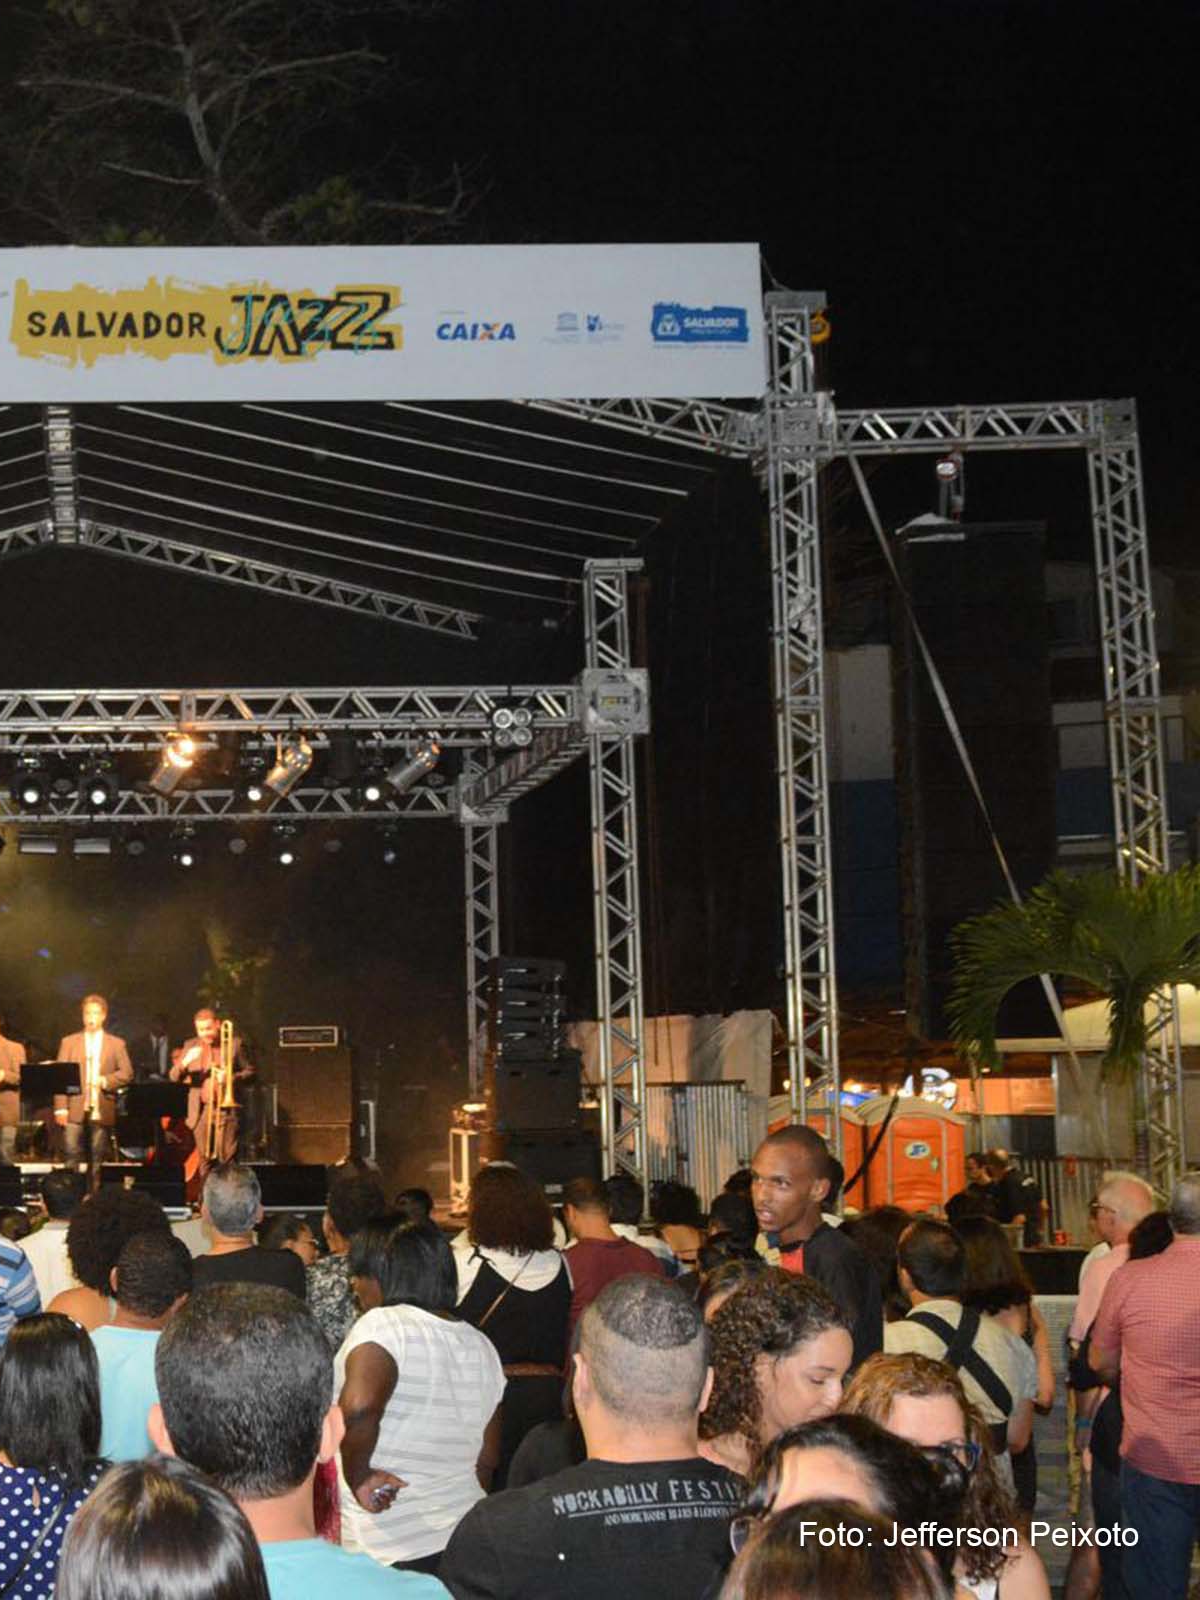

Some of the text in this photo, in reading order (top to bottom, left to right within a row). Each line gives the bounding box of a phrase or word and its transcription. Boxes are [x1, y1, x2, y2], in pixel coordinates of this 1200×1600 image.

[27, 291, 396, 356] SALVADOR JAZZ
[436, 323, 516, 341] CAIXA
